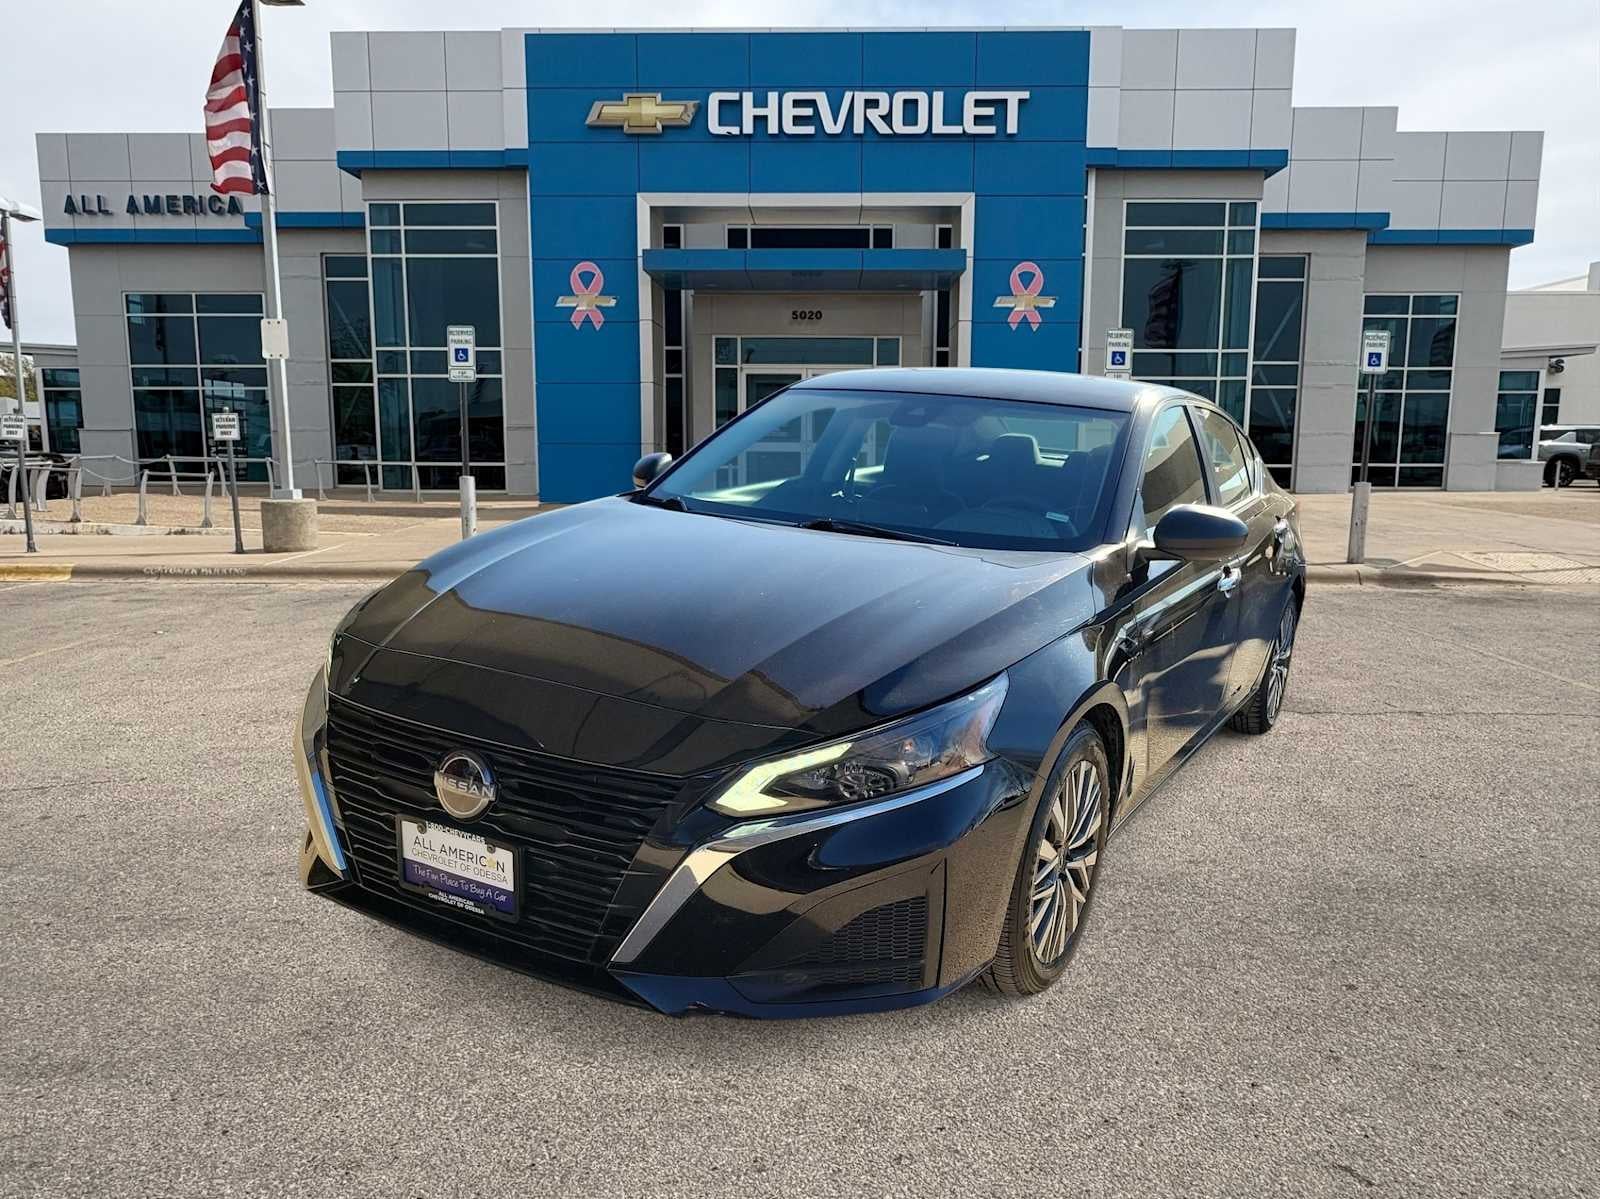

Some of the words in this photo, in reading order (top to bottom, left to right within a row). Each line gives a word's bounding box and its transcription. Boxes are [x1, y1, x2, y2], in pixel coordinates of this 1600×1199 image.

[708, 91, 1030, 135] CHEVROLET
[64, 195, 113, 216] ALL
[126, 195, 243, 216] AMERICA
[791, 310, 823, 320] 5020
[437, 774, 495, 800] NISSAN
[411, 847, 458, 869] CHEVROLET
[459, 861, 472, 873] OF
[473, 866, 509, 885] ODESSA
[413, 836, 435, 852] ALL
[439, 844, 506, 873] AMERICN
[439, 874, 459, 887] Place
